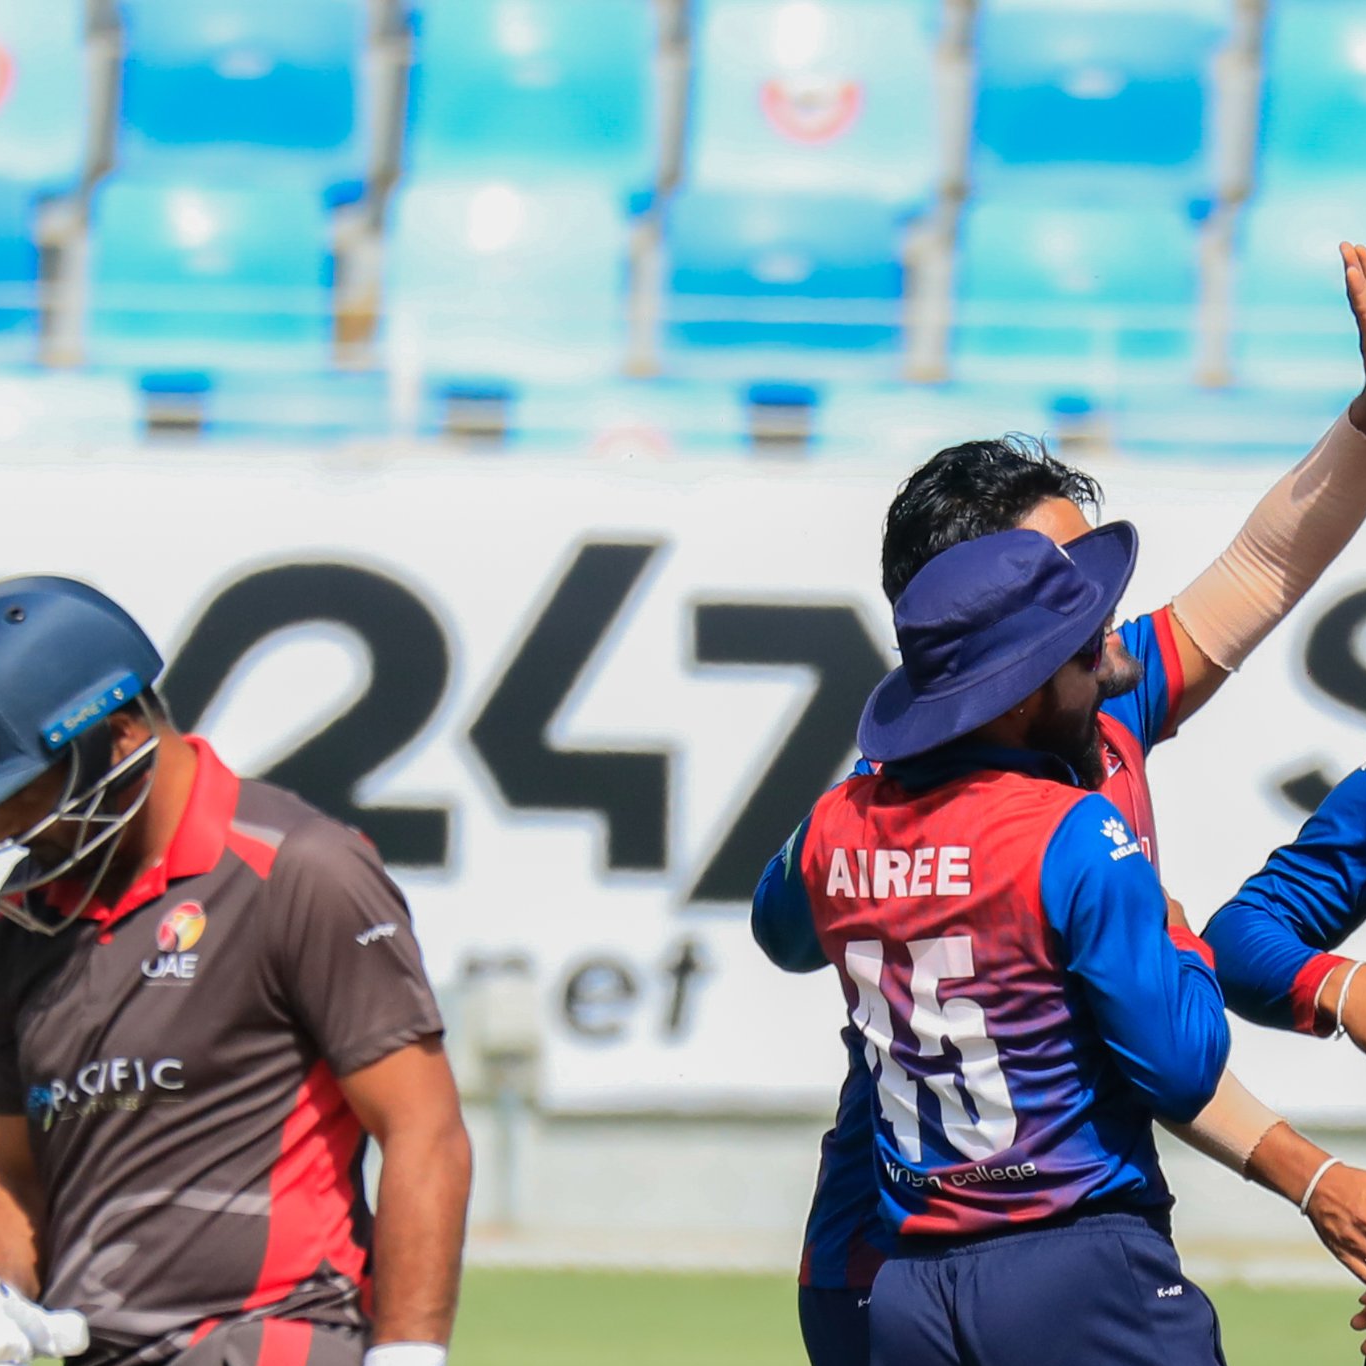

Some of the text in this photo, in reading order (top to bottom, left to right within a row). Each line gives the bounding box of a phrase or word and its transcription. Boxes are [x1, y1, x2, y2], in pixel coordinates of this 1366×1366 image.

[825, 845, 972, 899] AIREE
[141, 952, 199, 978] UAE
[844, 935, 1017, 1163] 15
[50, 1057, 185, 1113] PCIFIC
[950, 1161, 1038, 1187] college
[1156, 1284, 1183, 1298] K-AIR
